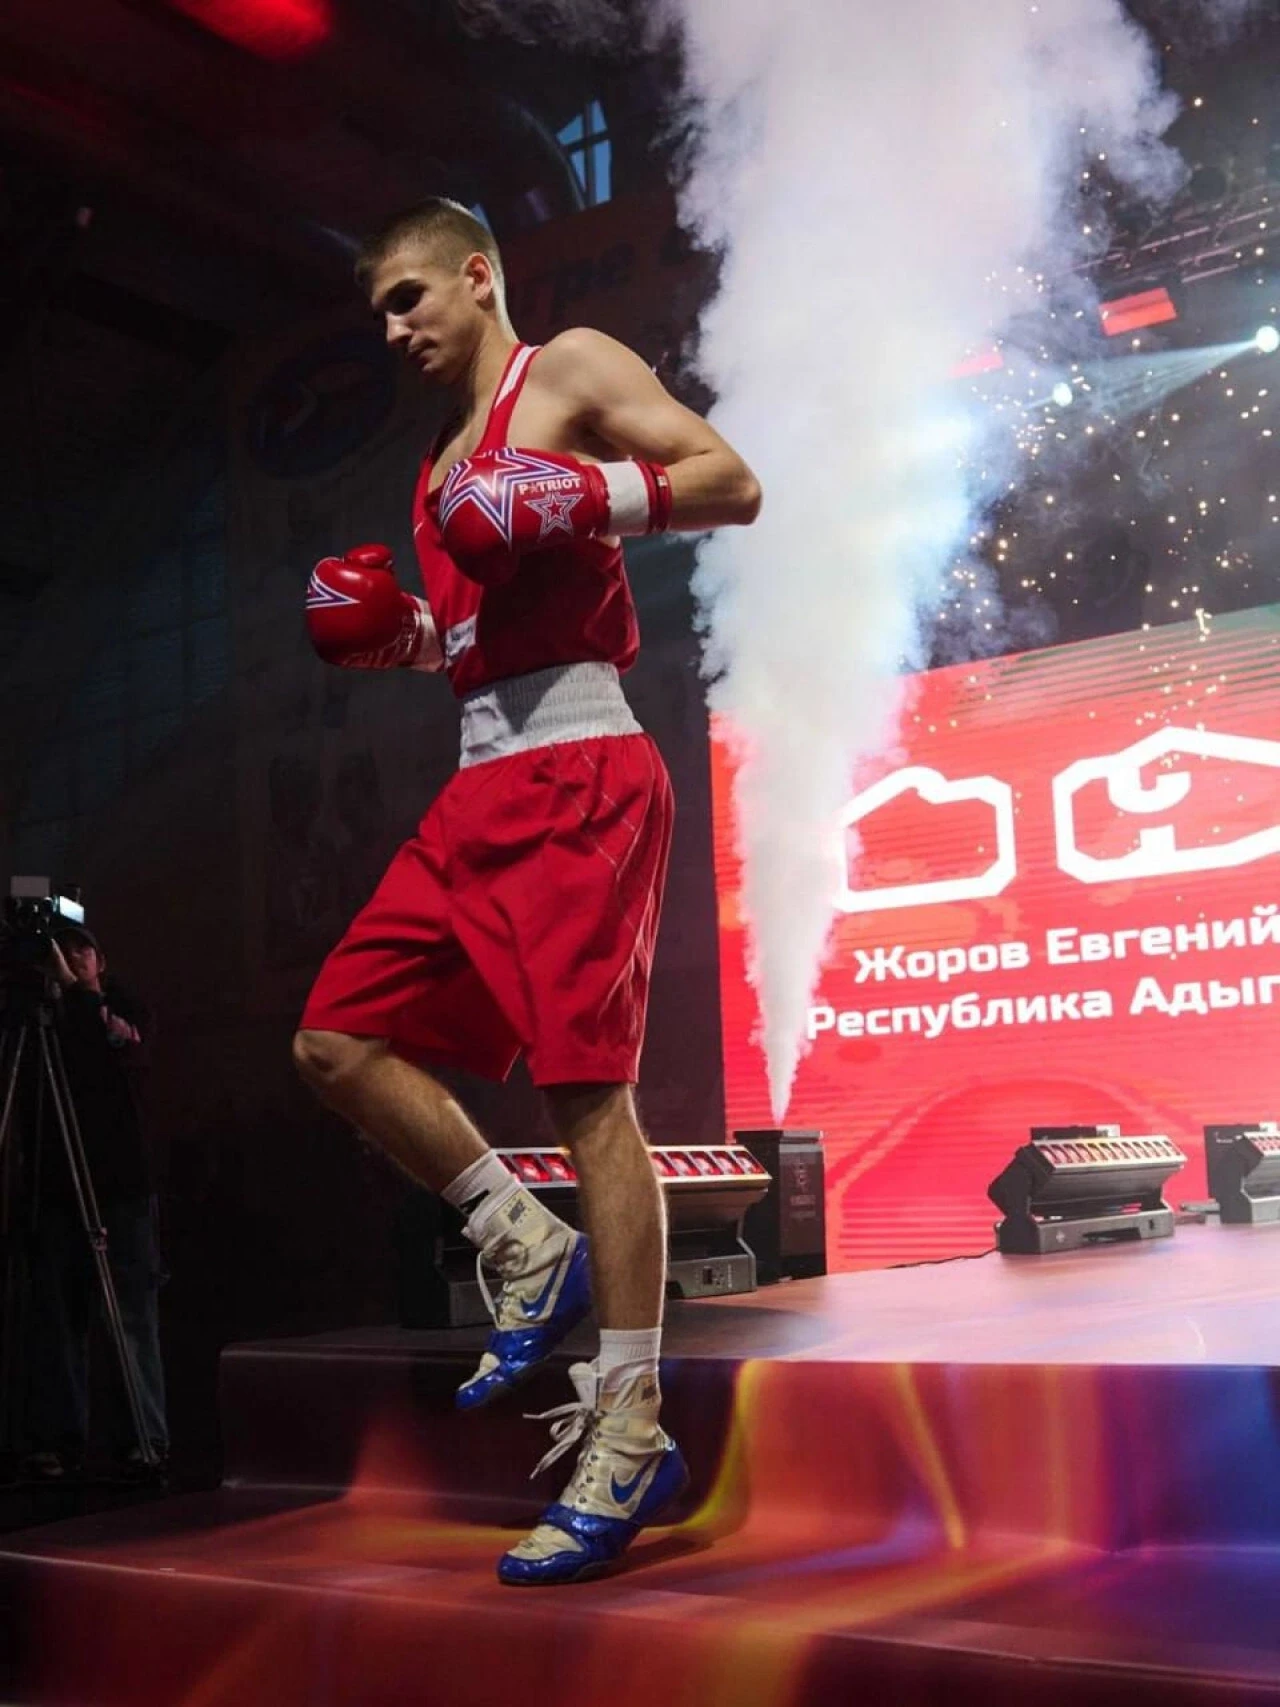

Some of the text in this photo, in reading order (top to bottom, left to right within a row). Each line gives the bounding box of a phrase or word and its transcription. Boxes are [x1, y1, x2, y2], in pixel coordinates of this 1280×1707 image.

[853, 903, 1280, 984] Жоров Евгений
[806, 990, 1113, 1041] Республика
